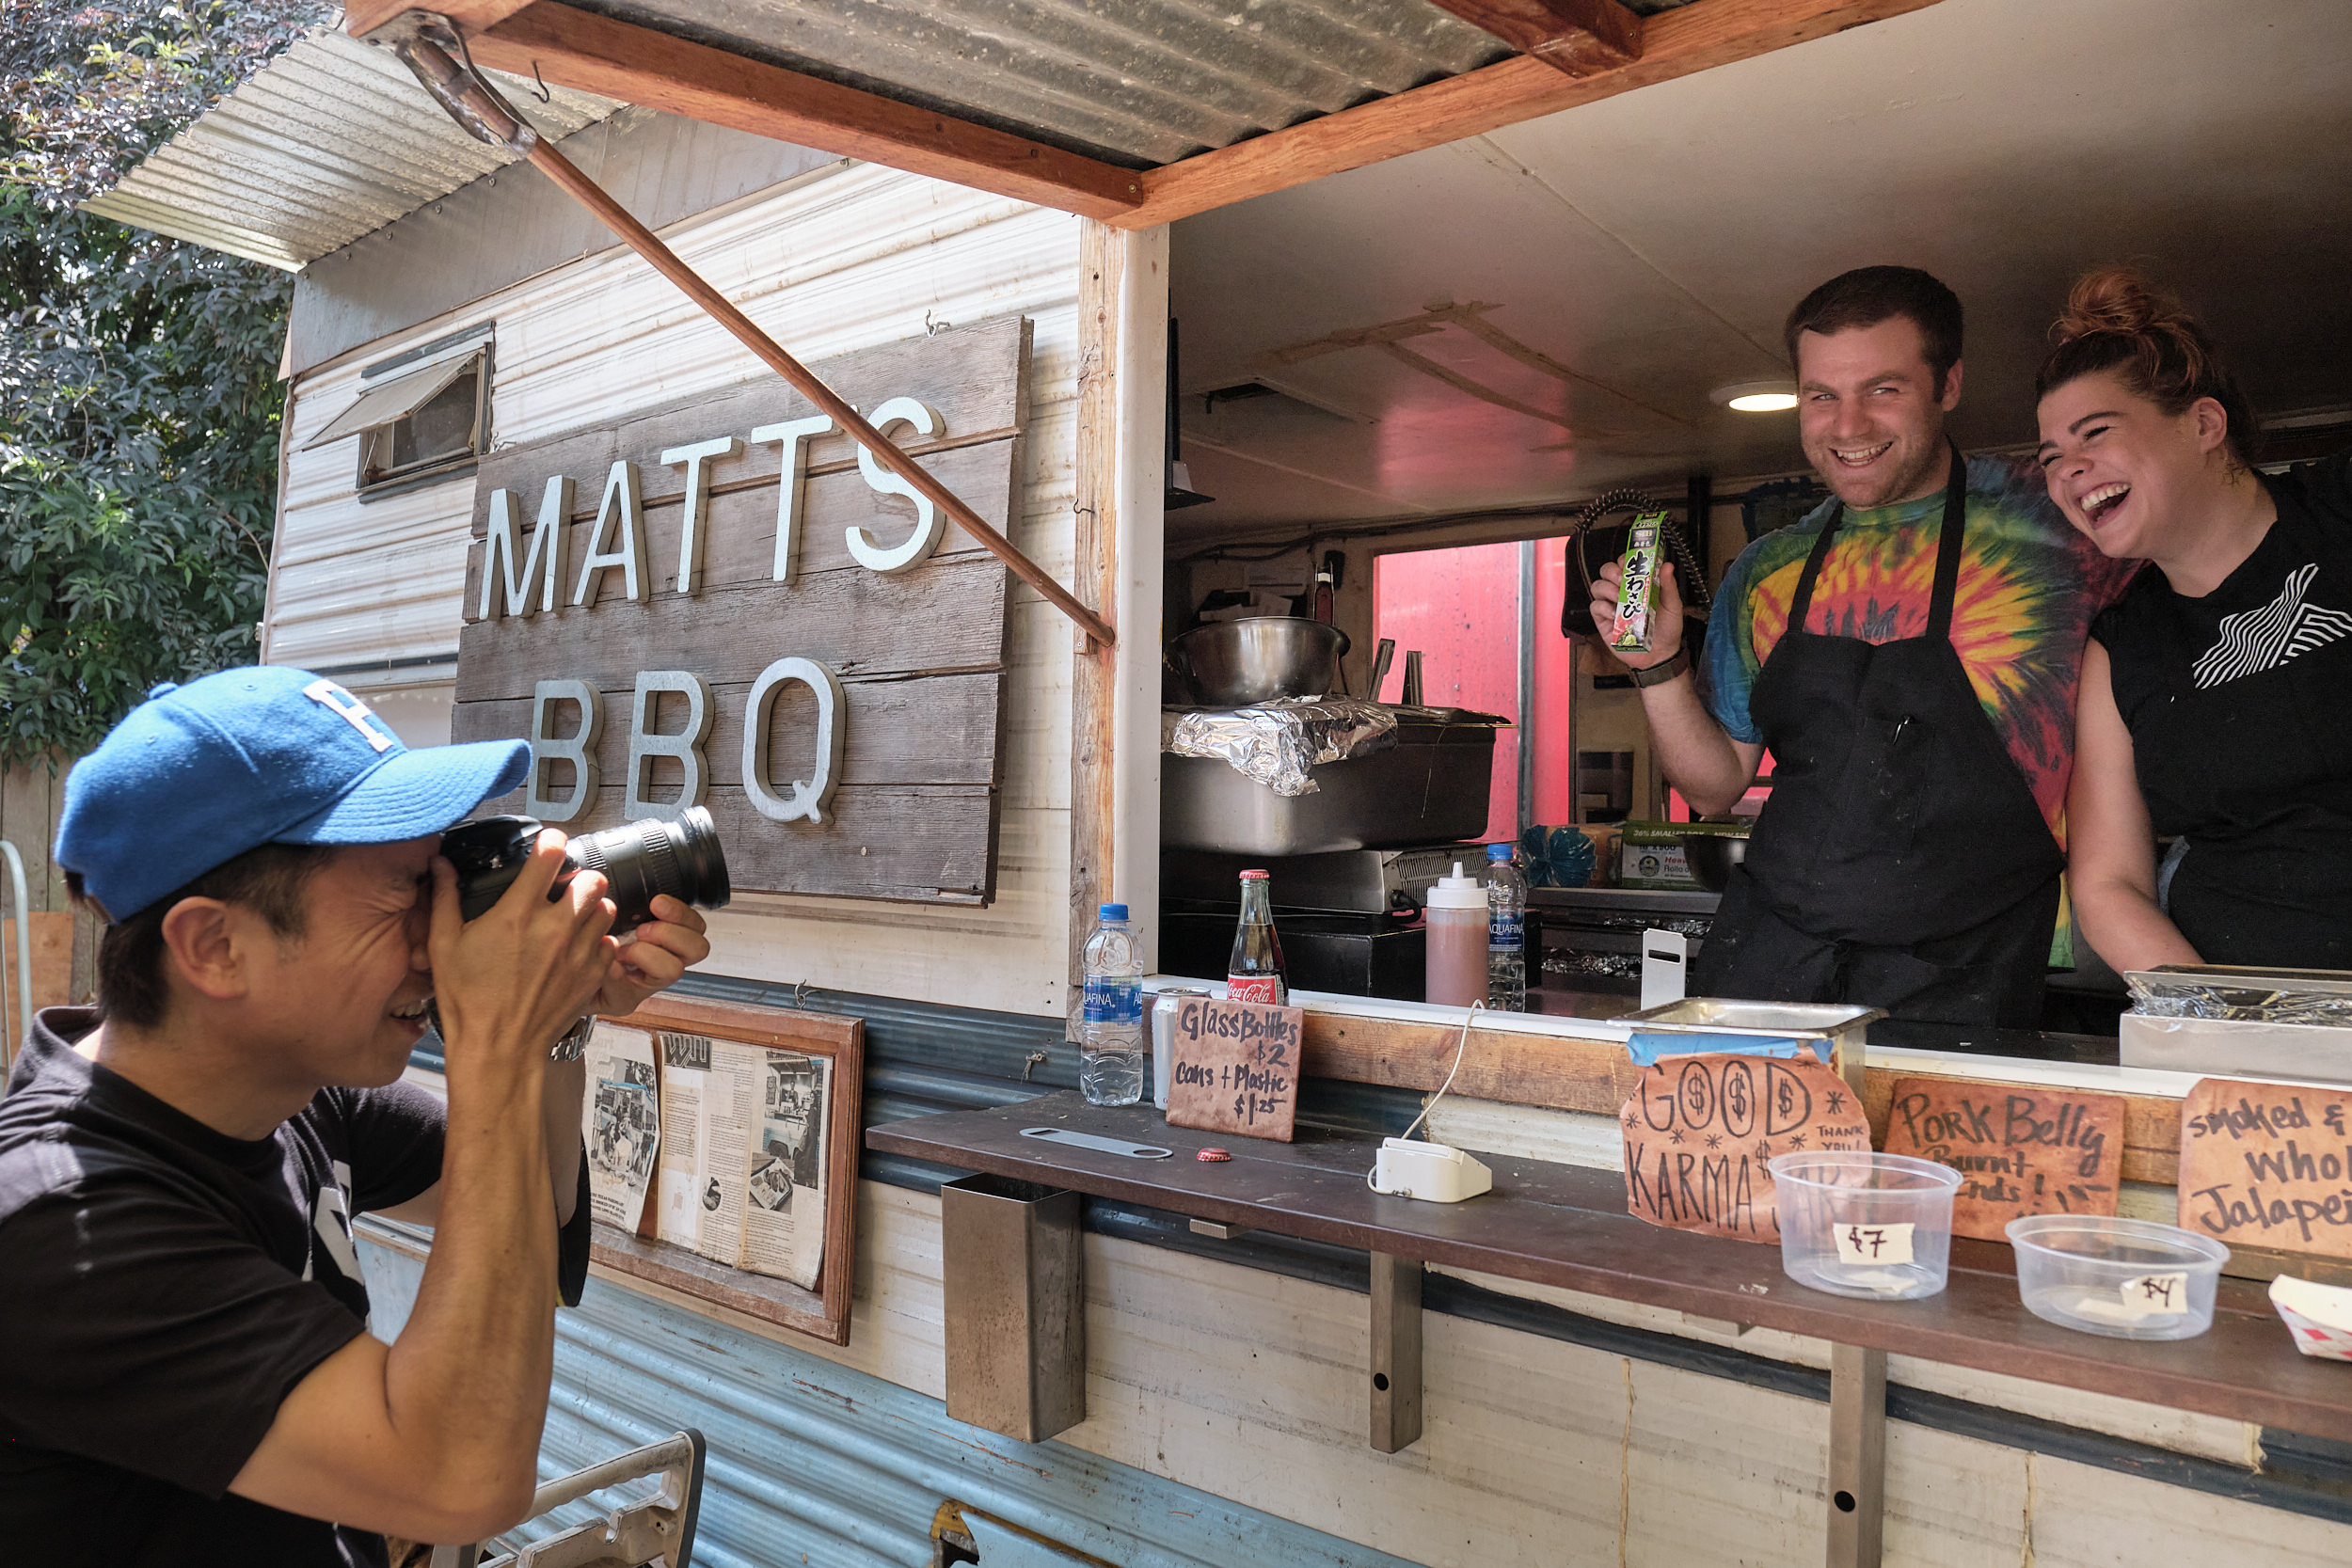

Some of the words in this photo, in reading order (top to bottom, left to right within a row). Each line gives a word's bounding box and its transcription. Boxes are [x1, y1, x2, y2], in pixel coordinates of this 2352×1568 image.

[524, 656, 847, 826] BBQ
[1083, 991, 1112, 1007] UAFINA
[1181, 1001, 1240, 1040] Glass
[1239, 1009, 1298, 1046] Bottles
[1254, 1039, 1290, 1068] $2
[1233, 1064, 1289, 1094] Plastic
[1233, 1093, 1288, 1126] $1.25
[1641, 1060, 1812, 1138] GOOD
[1816, 1125, 1864, 1136] THANK
[2003, 1094, 2106, 1178] Belly
[1627, 1140, 1756, 1234] KARMA
[1848, 1226, 1887, 1259] $7
